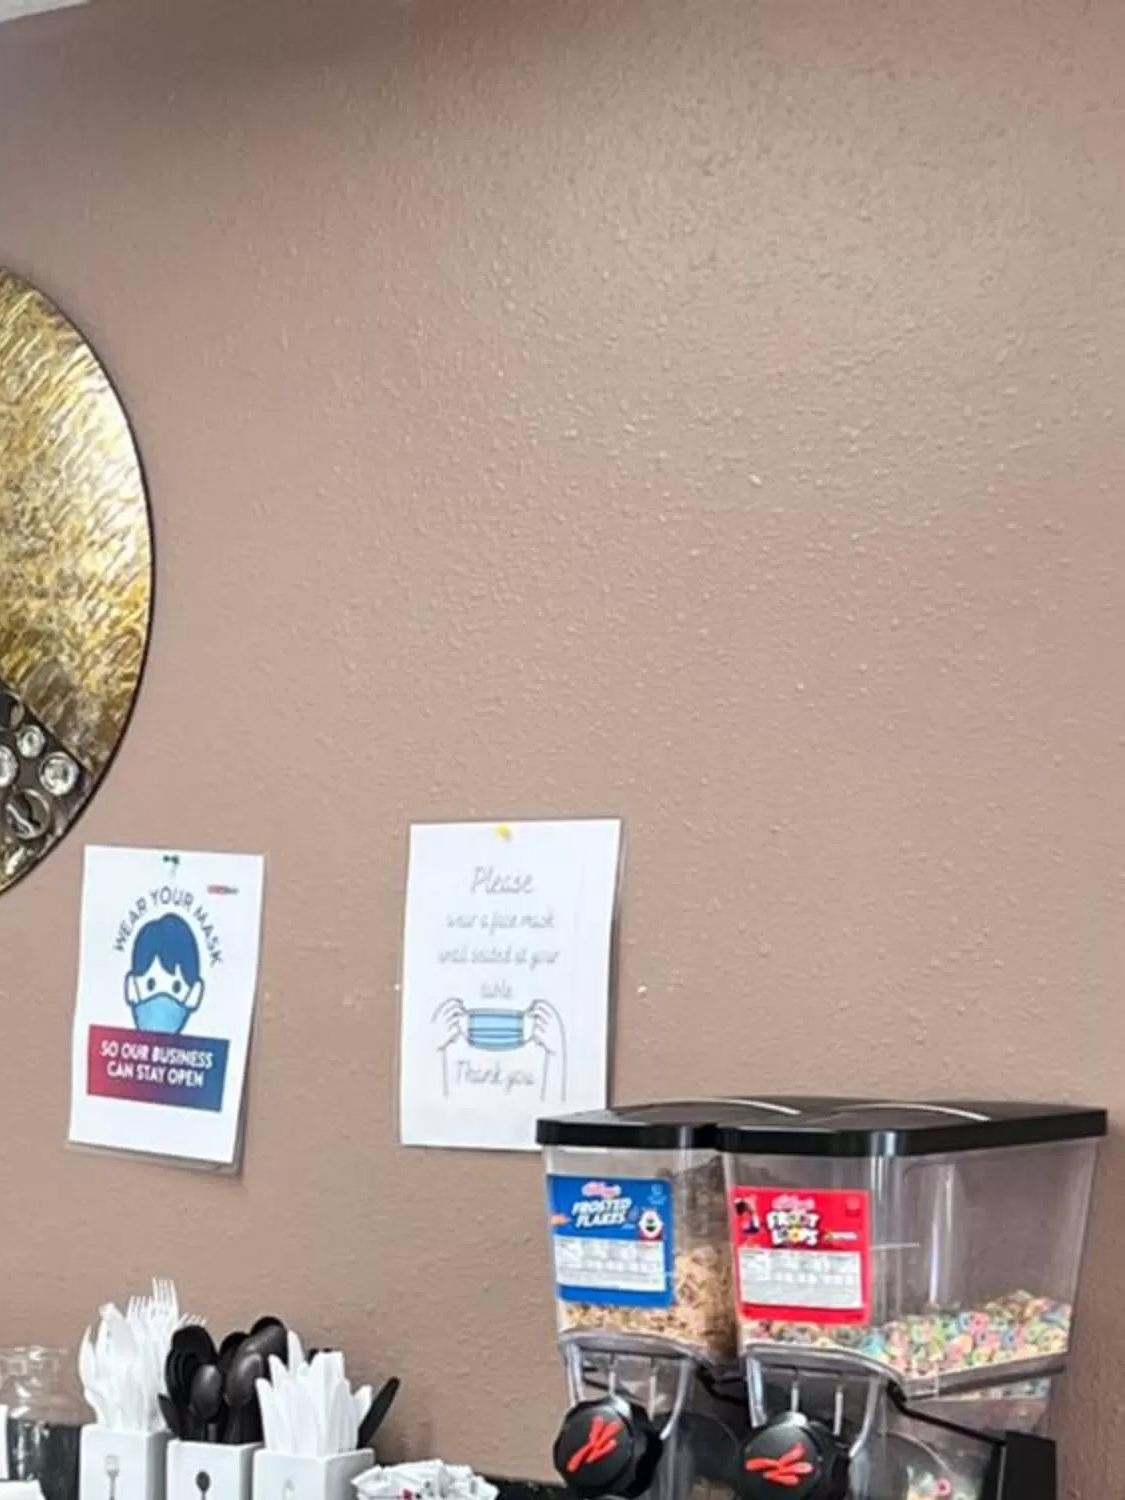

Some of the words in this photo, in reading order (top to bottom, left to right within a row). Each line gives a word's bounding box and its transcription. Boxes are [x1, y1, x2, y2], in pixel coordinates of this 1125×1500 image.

[470, 865, 534, 894] Please
[113, 896, 148, 952] WEAR
[148, 885, 195, 912] YOUR
[193, 904, 224, 968] MASK
[100, 1039, 119, 1058] SO
[120, 1042, 150, 1062] OUR
[150, 1045, 214, 1070] BUSINESS
[106, 1060, 135, 1079] CAN
[135, 1063, 167, 1083] STAY
[167, 1067, 205, 1088] OPEN
